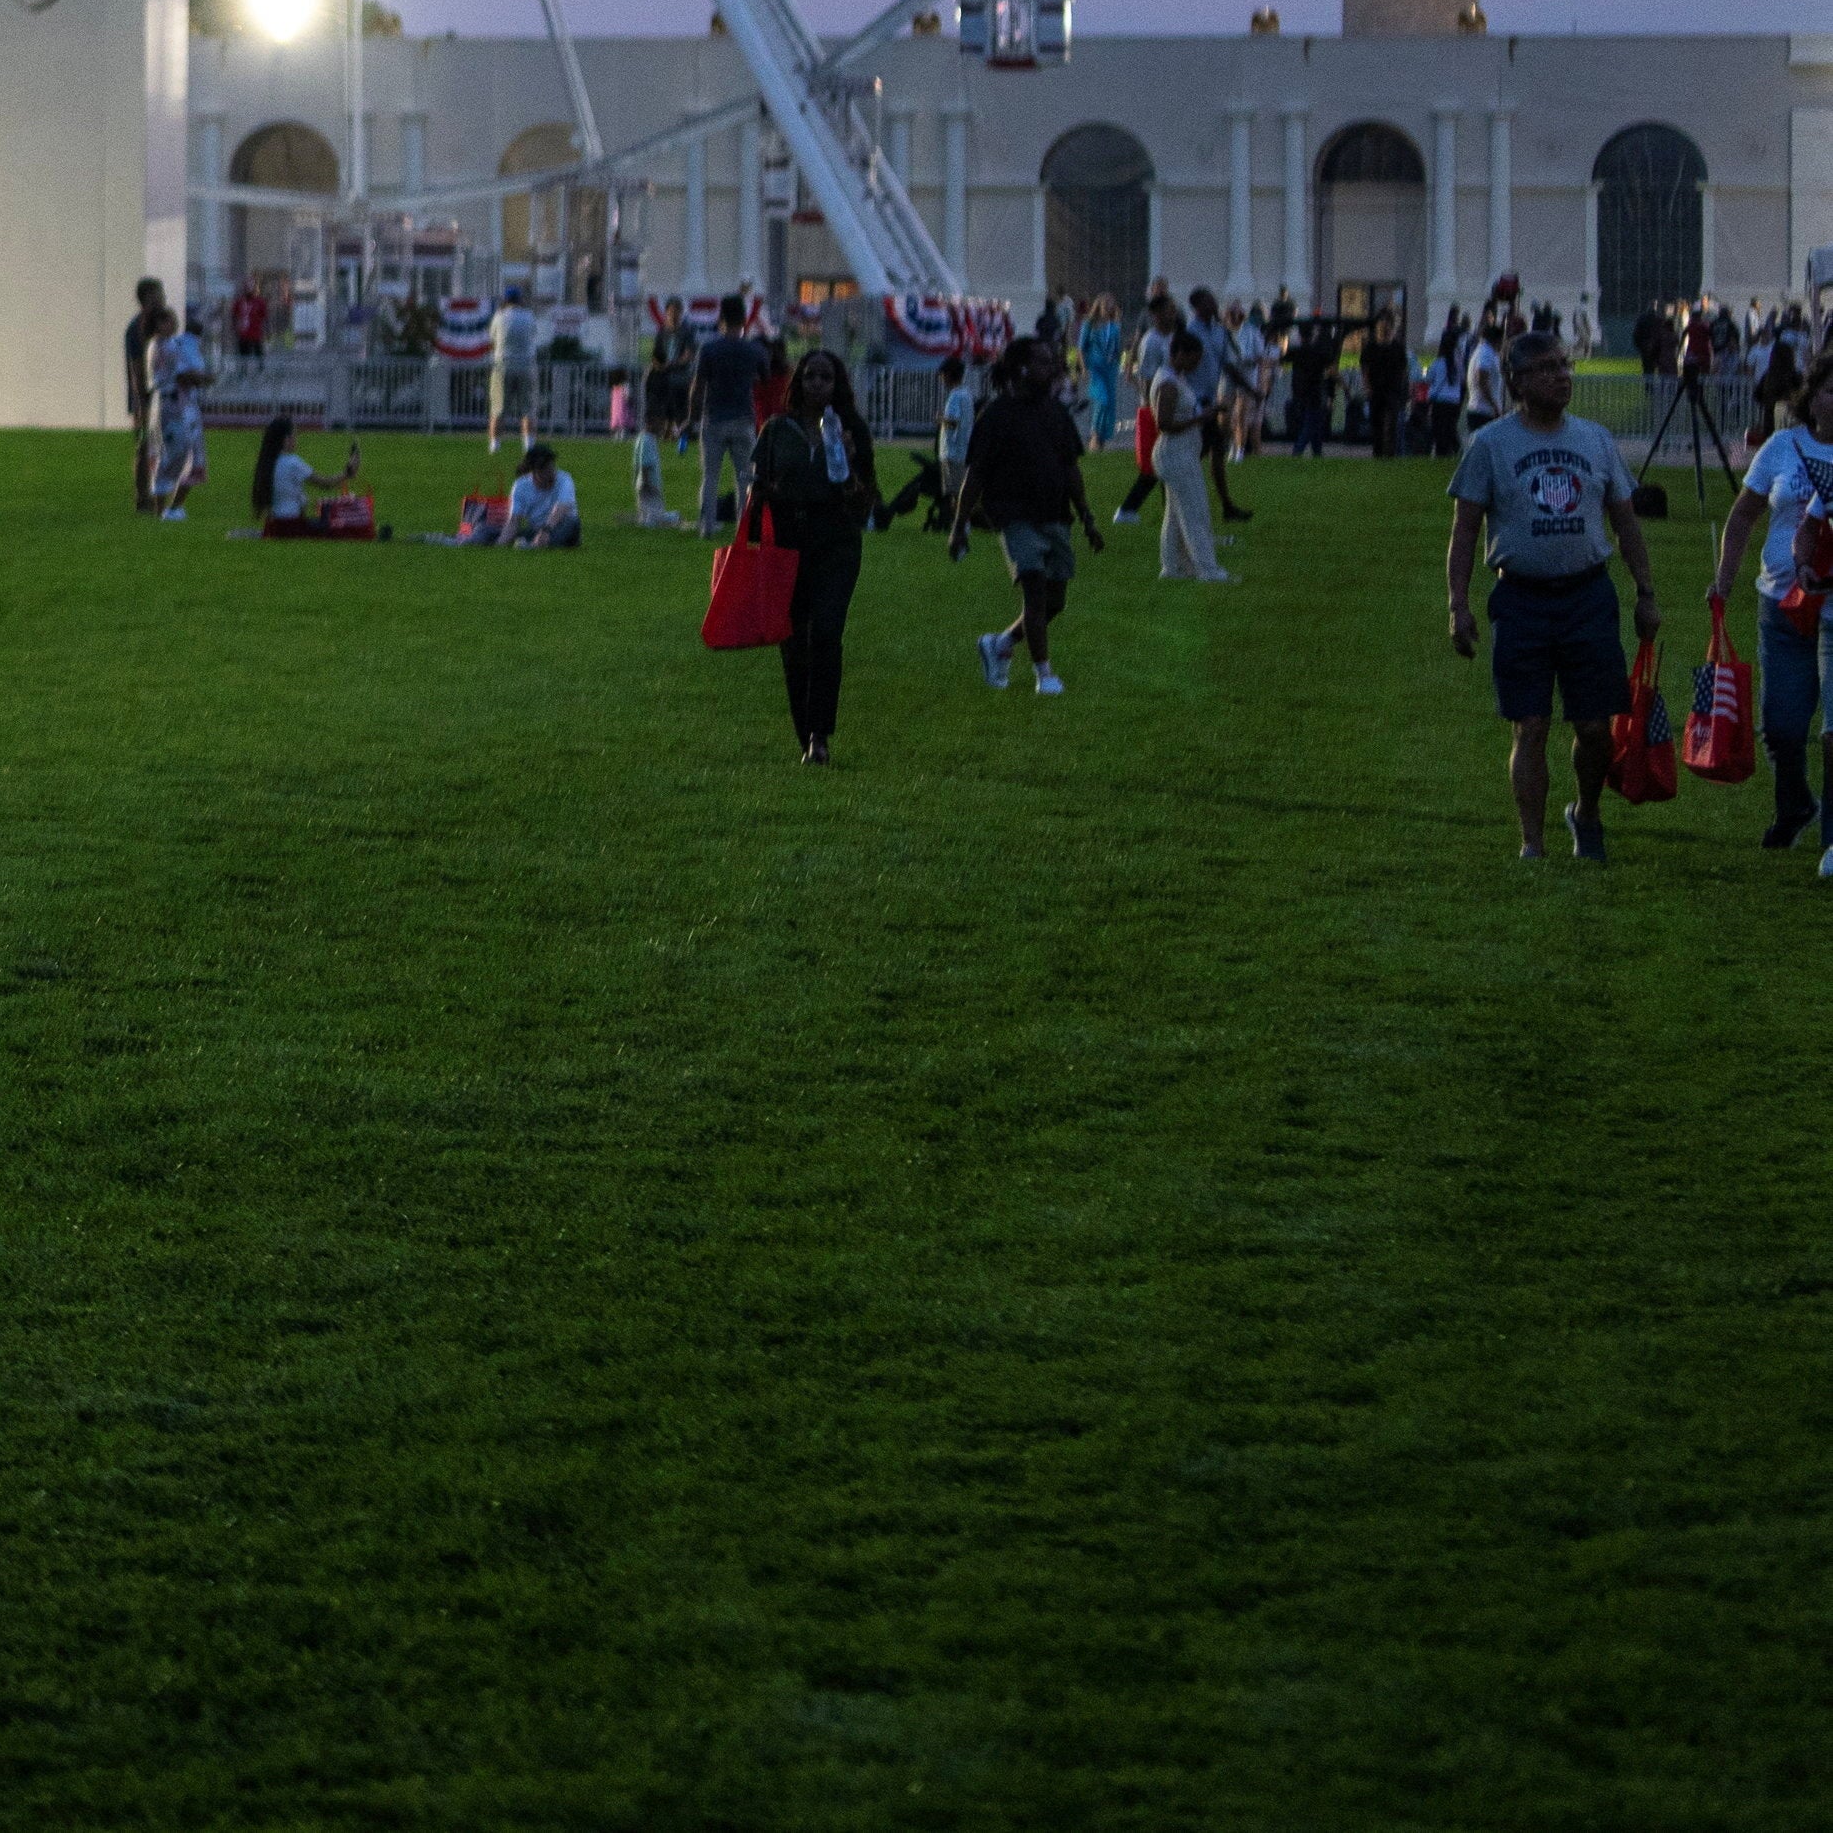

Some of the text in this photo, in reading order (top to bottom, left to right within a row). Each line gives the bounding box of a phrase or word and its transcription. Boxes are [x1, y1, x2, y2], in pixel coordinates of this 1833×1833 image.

[1514, 448, 1593, 478] UNITED STATES
[1532, 517, 1585, 537] SOCCER
